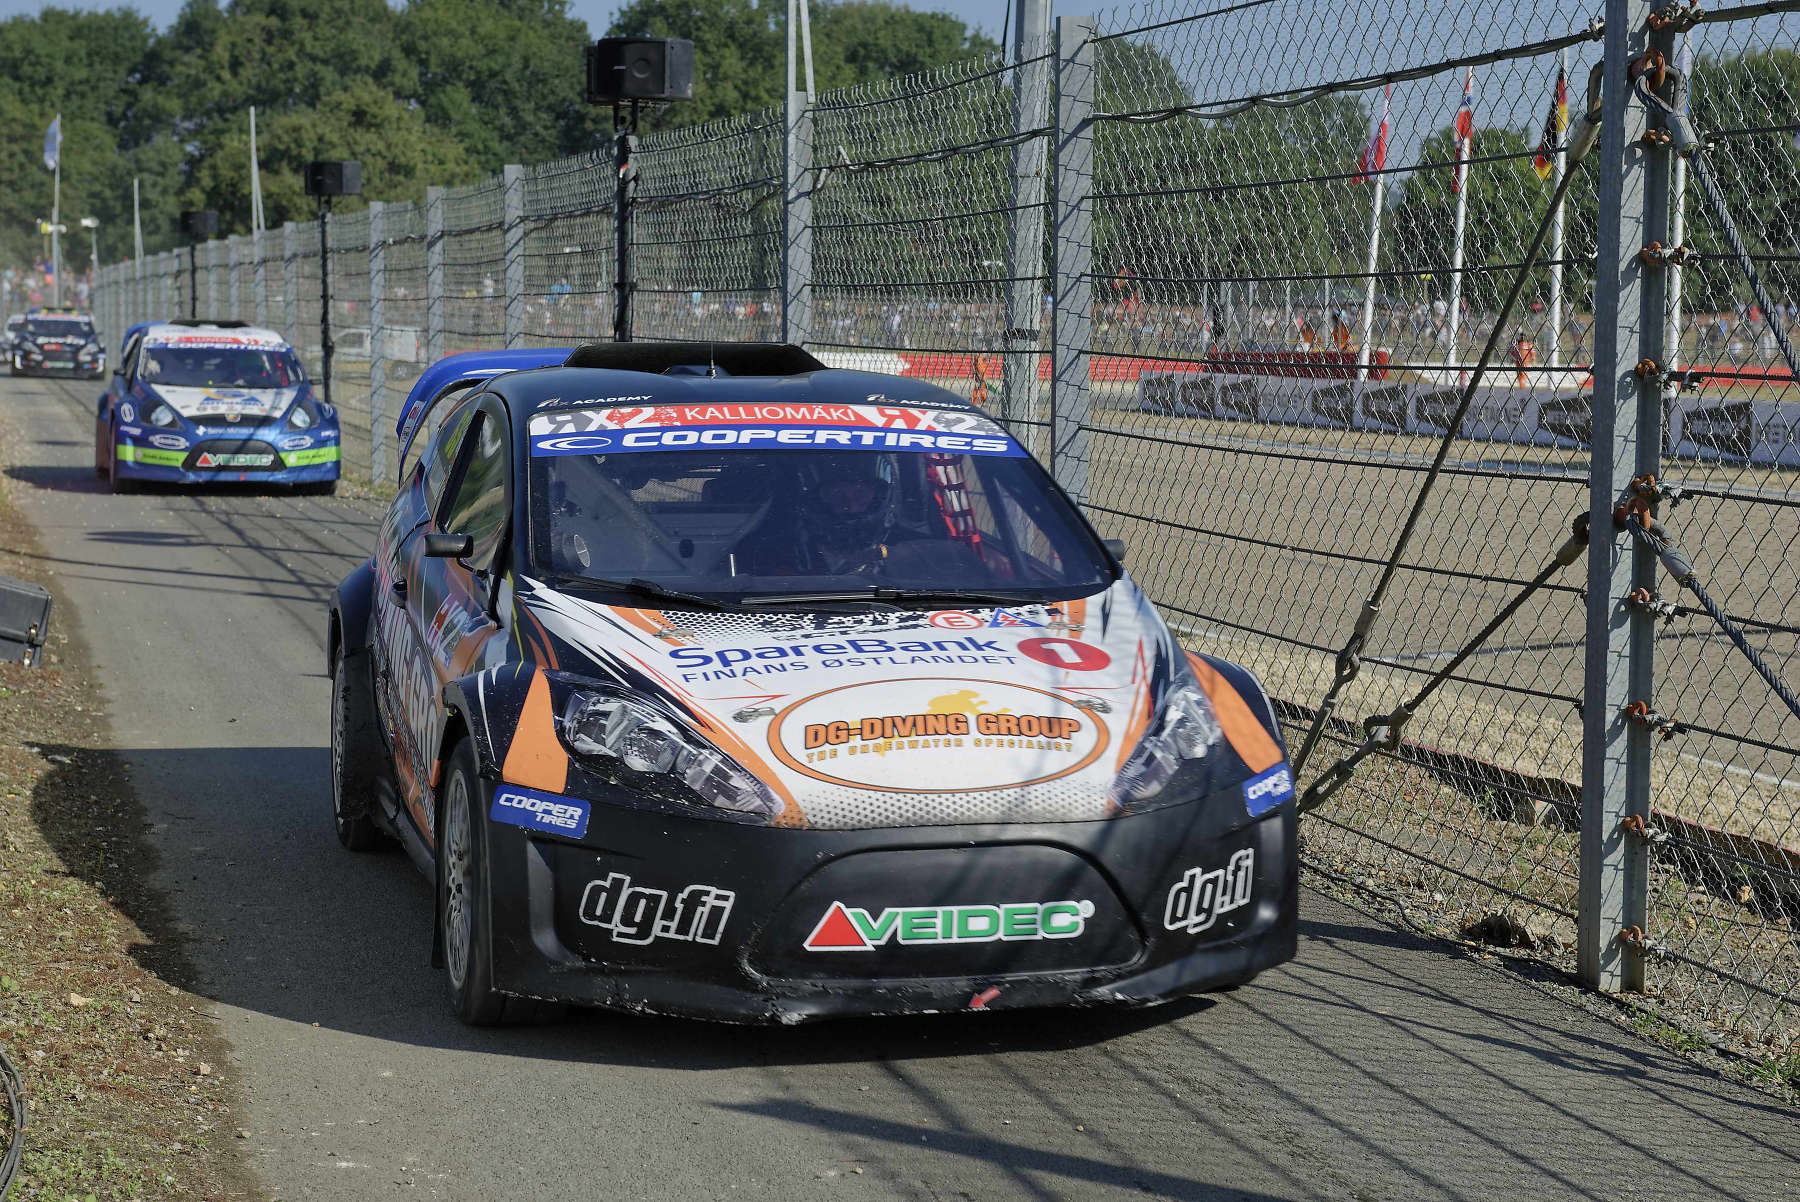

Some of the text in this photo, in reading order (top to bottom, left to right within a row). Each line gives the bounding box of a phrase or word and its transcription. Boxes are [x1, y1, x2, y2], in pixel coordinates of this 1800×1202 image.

[573, 395, 653, 405] ACADEMY
[685, 404, 857, 421] KALLIOMÄKI
[900, 399, 971, 410] ACADEMY
[668, 636, 1085, 669] SpareBank 1
[682, 655, 1017, 683] FINANS ØSTLANDET
[804, 713, 1080, 750] DG-DIVING GROUP
[806, 737, 1073, 764] THE UNDERWATER SPECIALIST
[499, 793, 583, 819] COOPER
[535, 812, 579, 829] TIRES
[1163, 847, 1255, 935] dg.fi
[578, 872, 736, 946] dg.fi
[848, 901, 1087, 945] VEIDEC
